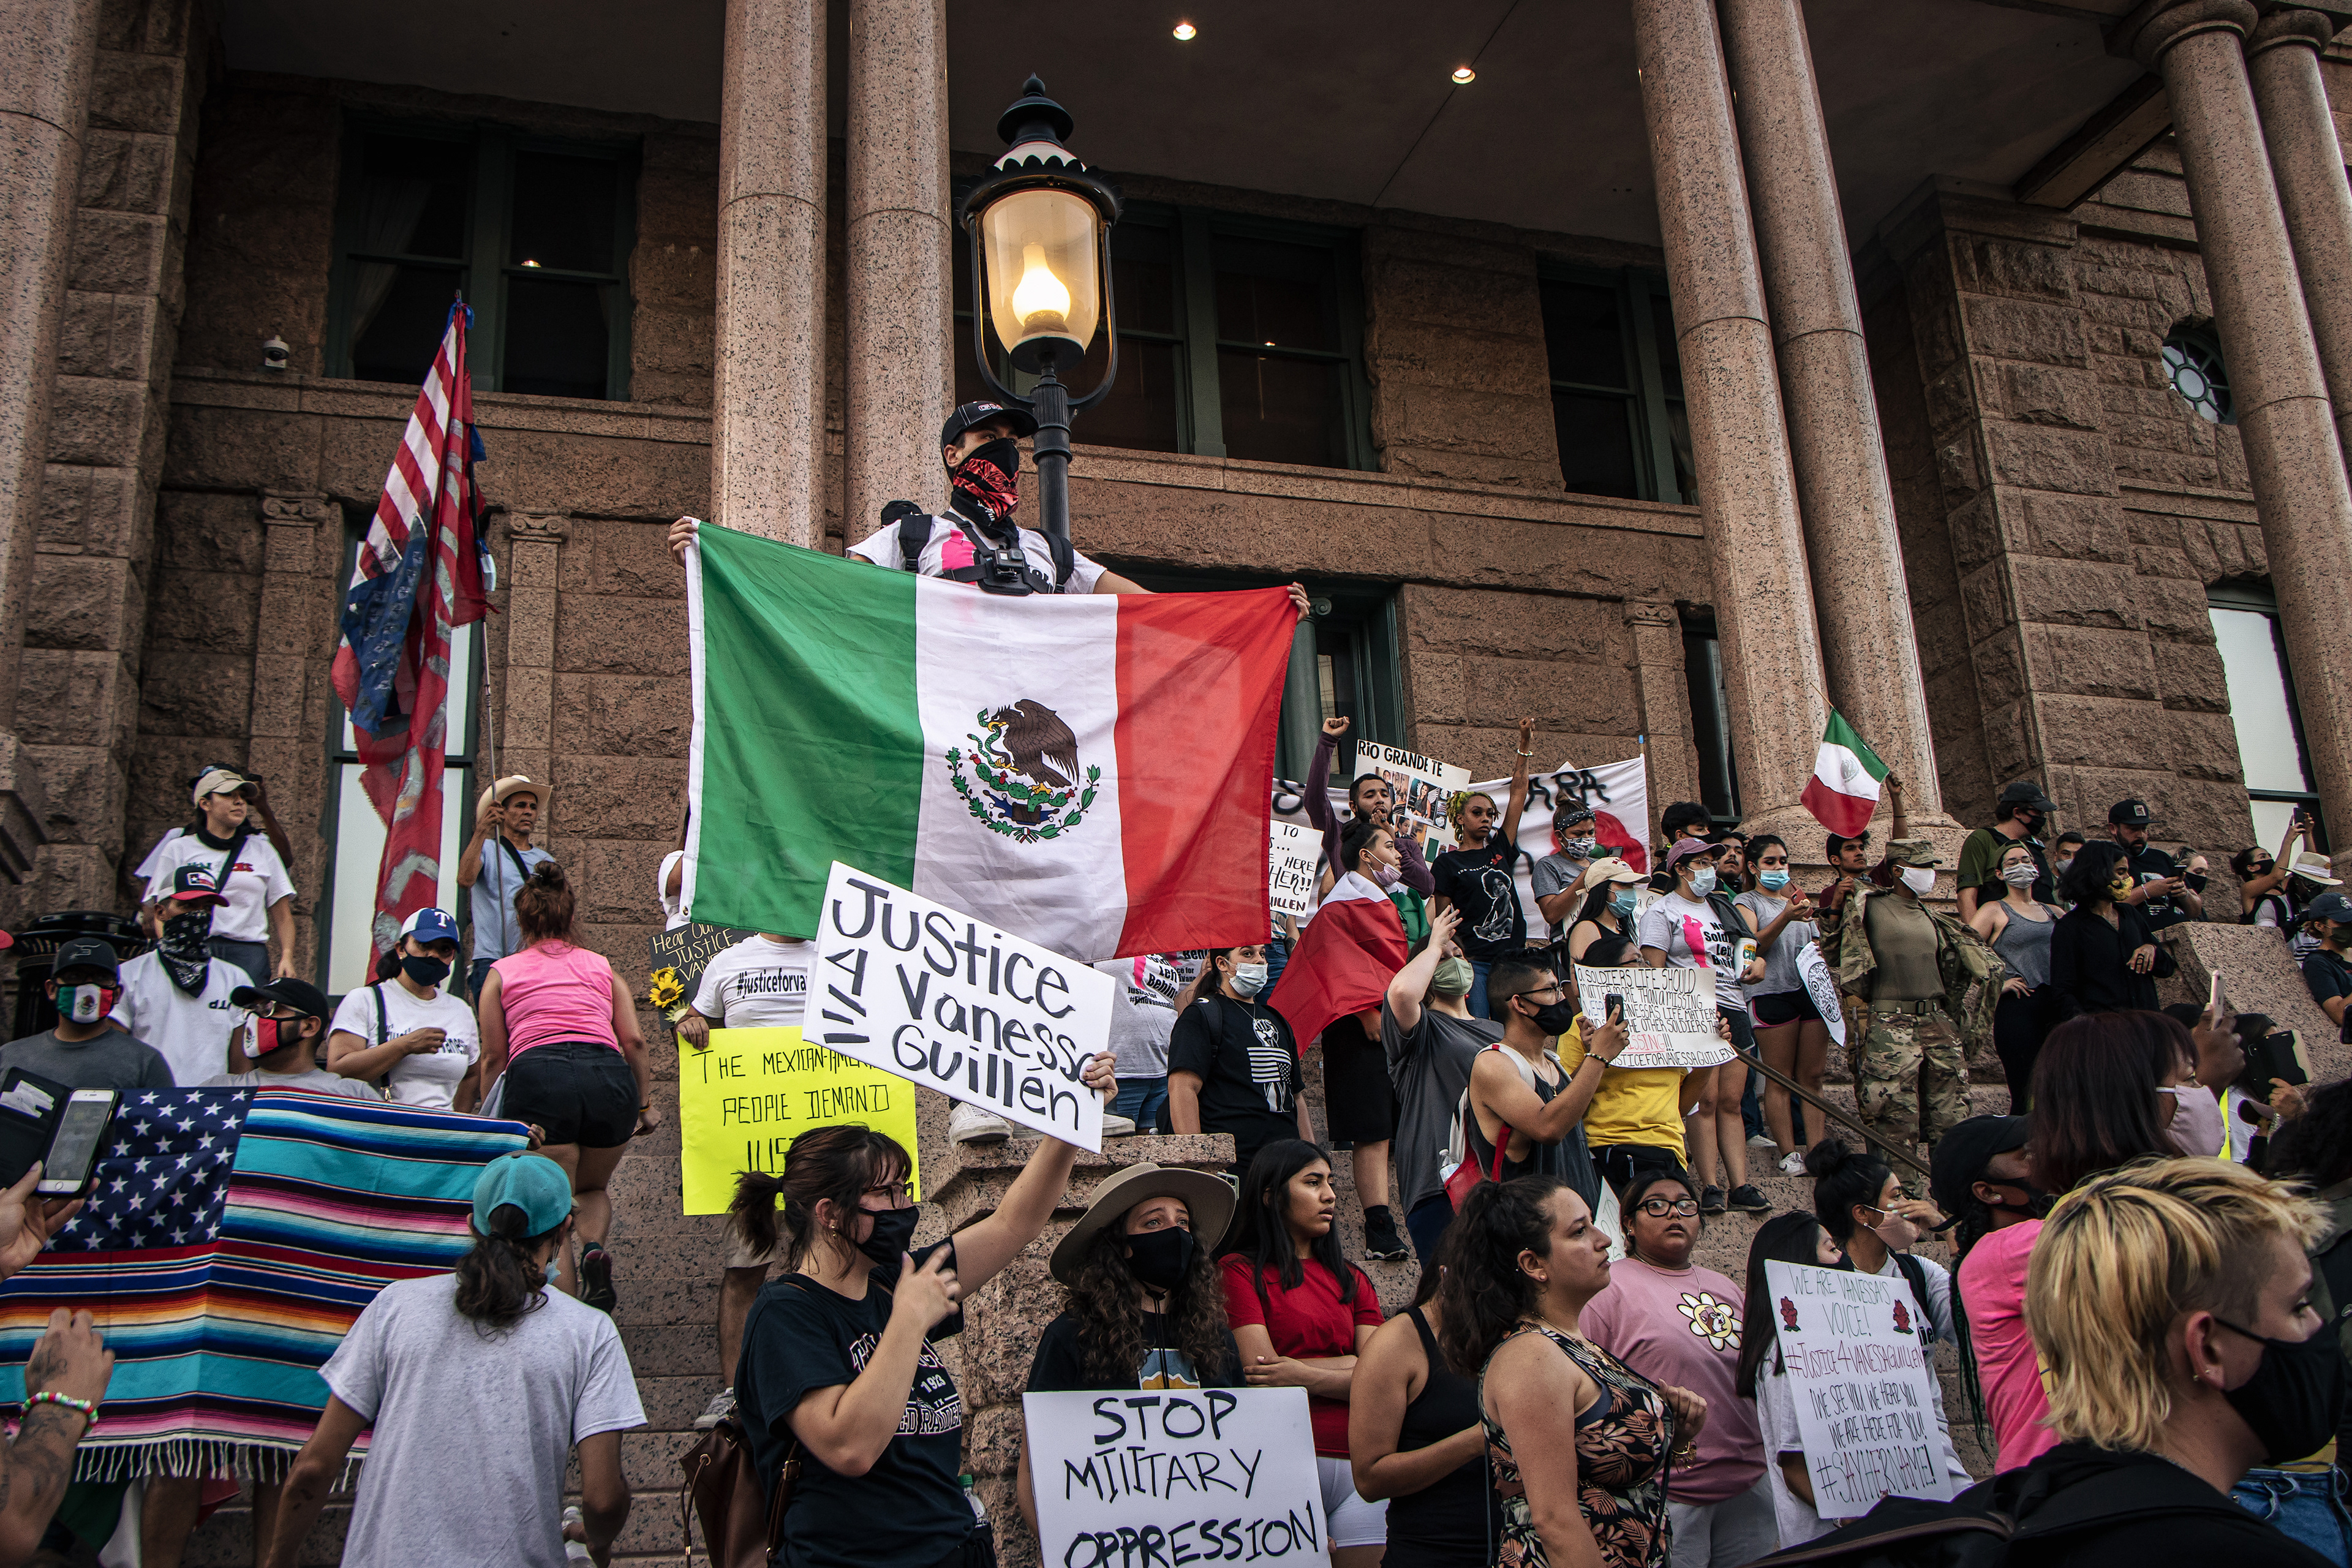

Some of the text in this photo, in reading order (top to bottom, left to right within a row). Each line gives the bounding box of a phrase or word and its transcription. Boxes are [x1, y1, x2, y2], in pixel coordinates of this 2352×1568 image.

[1384, 747, 1428, 772] GRANDE
[1432, 760, 1442, 777] TE
[1283, 824, 1298, 837] TO
[1284, 857, 1314, 875] HERE
[434, 911, 450, 929] T
[652, 930, 687, 954] Hear
[1703, 931, 1729, 943] Sold
[737, 967, 807, 999] #justiceforva
[1585, 969, 1632, 987] SOLDIERS
[1634, 968, 1660, 989] LIFE
[1662, 968, 1696, 994] SHOULD
[1583, 1000, 1716, 1020] WEAP ANESSA'S LIFE MATTERS
[1641, 1018, 1667, 1032] OTHER
[1667, 1019, 1707, 1033] SOLDIERS
[1627, 1033, 1673, 1051] SSING!!!
[692, 1050, 745, 1084] THE
[1612, 1047, 1735, 1066] USTICEFORVANESSAGUILLEN
[723, 1084, 889, 1126] PEOPLE DEMAND
[1788, 1265, 1891, 1305] WE ARE VANESSA'S
[1822, 1302, 1871, 1338] VOICE!
[920, 1374, 946, 1393] 1923
[1830, 1384, 1848, 1415] SEE
[1879, 1378, 1901, 1406] HEAR
[933, 1398, 944, 1408] TX
[894, 1408, 918, 1435] ED
[1093, 1390, 1237, 1444] STOP
[1828, 1420, 1846, 1450] WE
[1844, 1416, 1862, 1444] ARE
[1860, 1414, 1887, 1442] HERE
[1885, 1412, 1902, 1439] FOR
[1064, 1446, 1262, 1503] MILITARY
[1064, 1500, 1319, 1568] OPPRESSION
